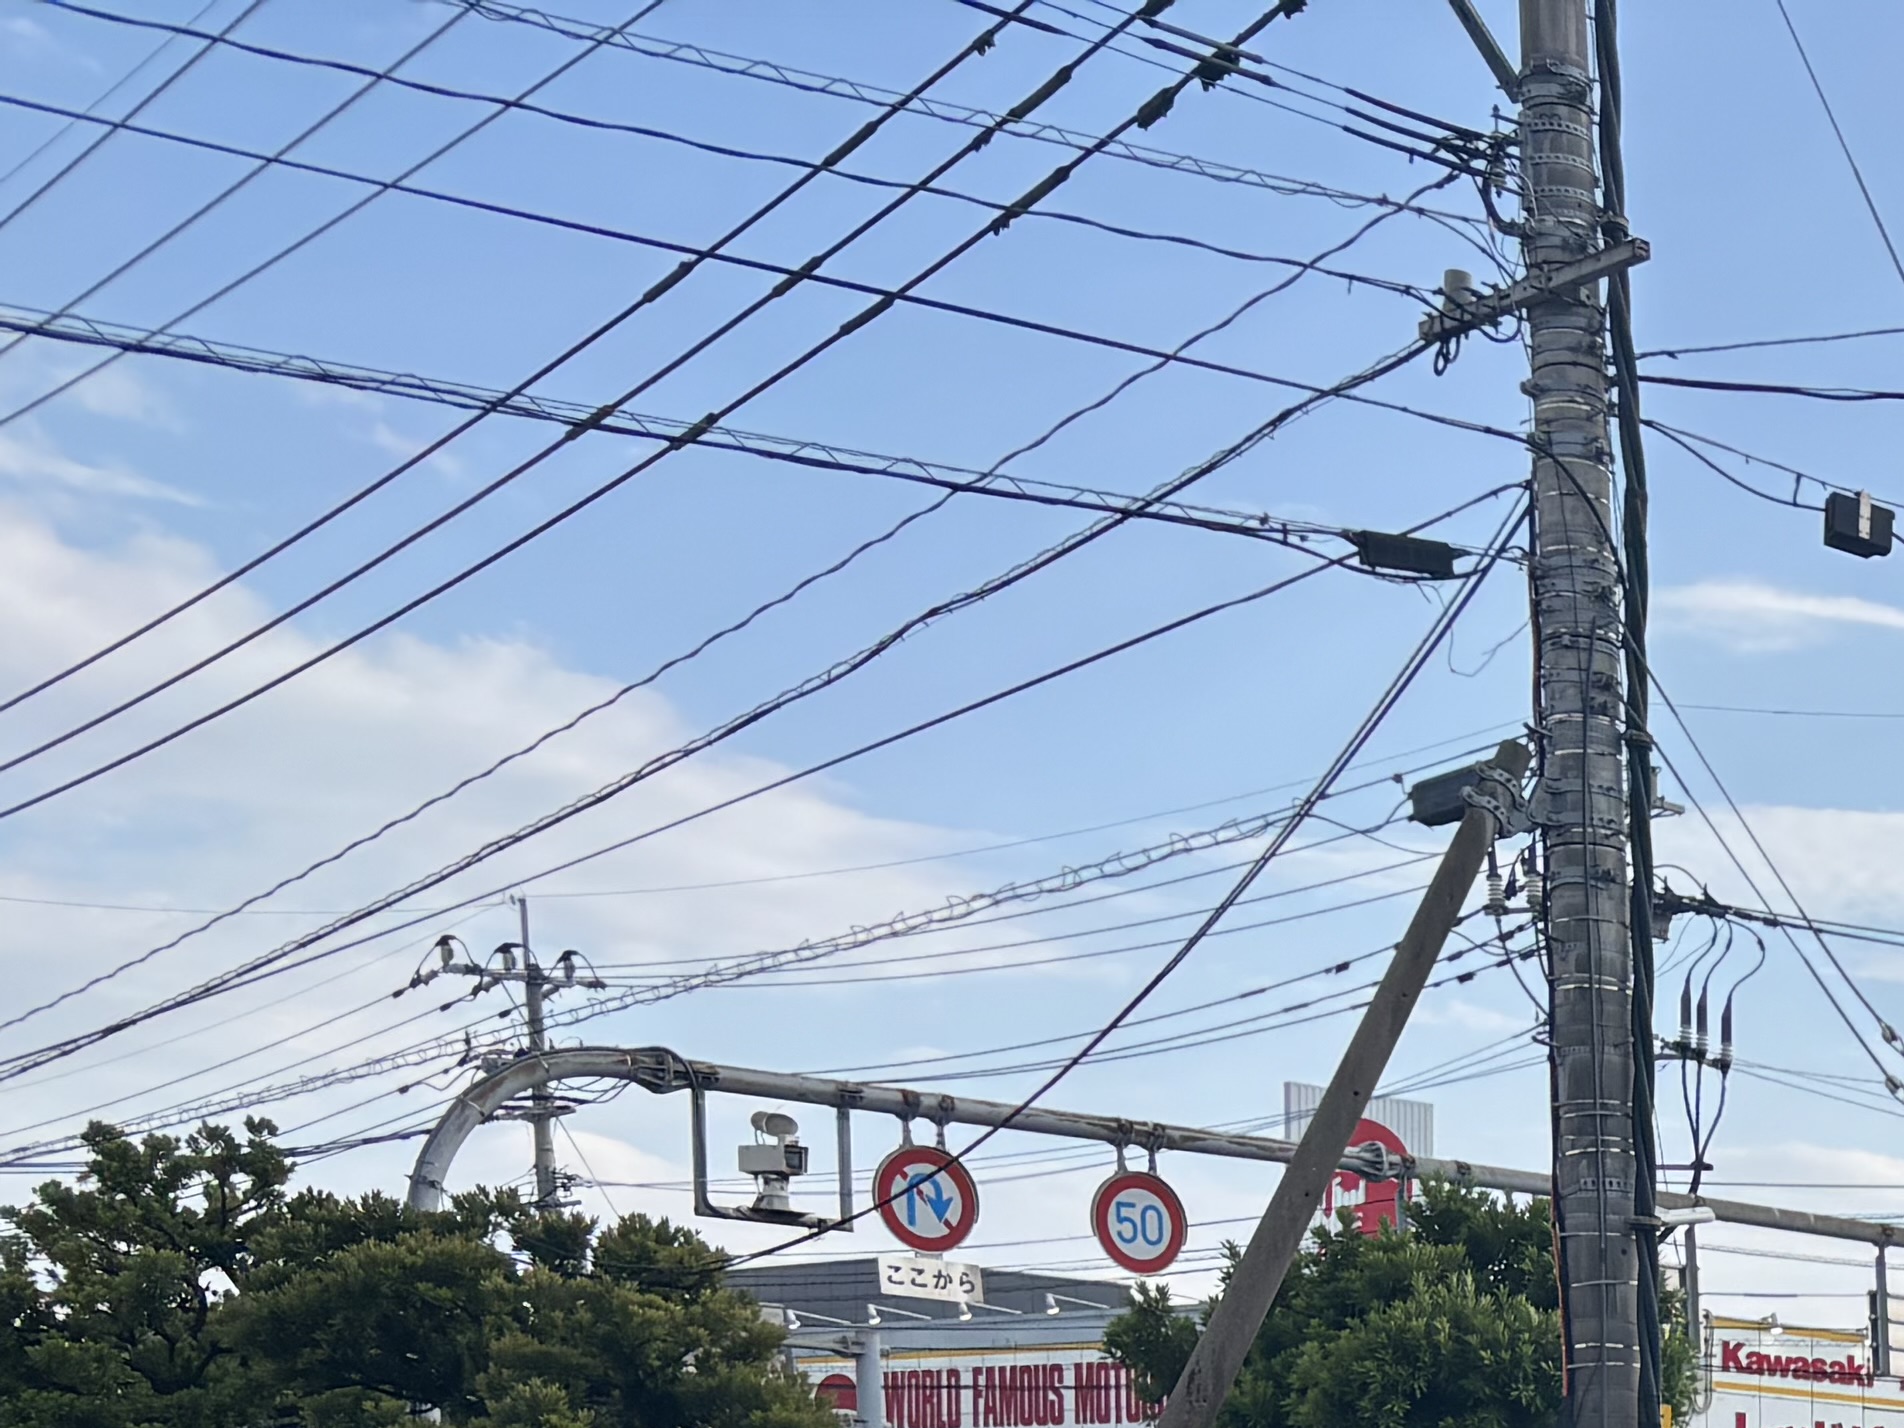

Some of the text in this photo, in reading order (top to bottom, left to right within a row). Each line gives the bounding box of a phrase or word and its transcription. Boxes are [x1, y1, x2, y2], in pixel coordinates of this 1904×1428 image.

[1115, 1201, 1164, 1246] 50
[887, 1265, 975, 1294] ここから
[1721, 1340, 1873, 1388] Kawasaki
[972, 1363, 1065, 1428] FAMOUS
